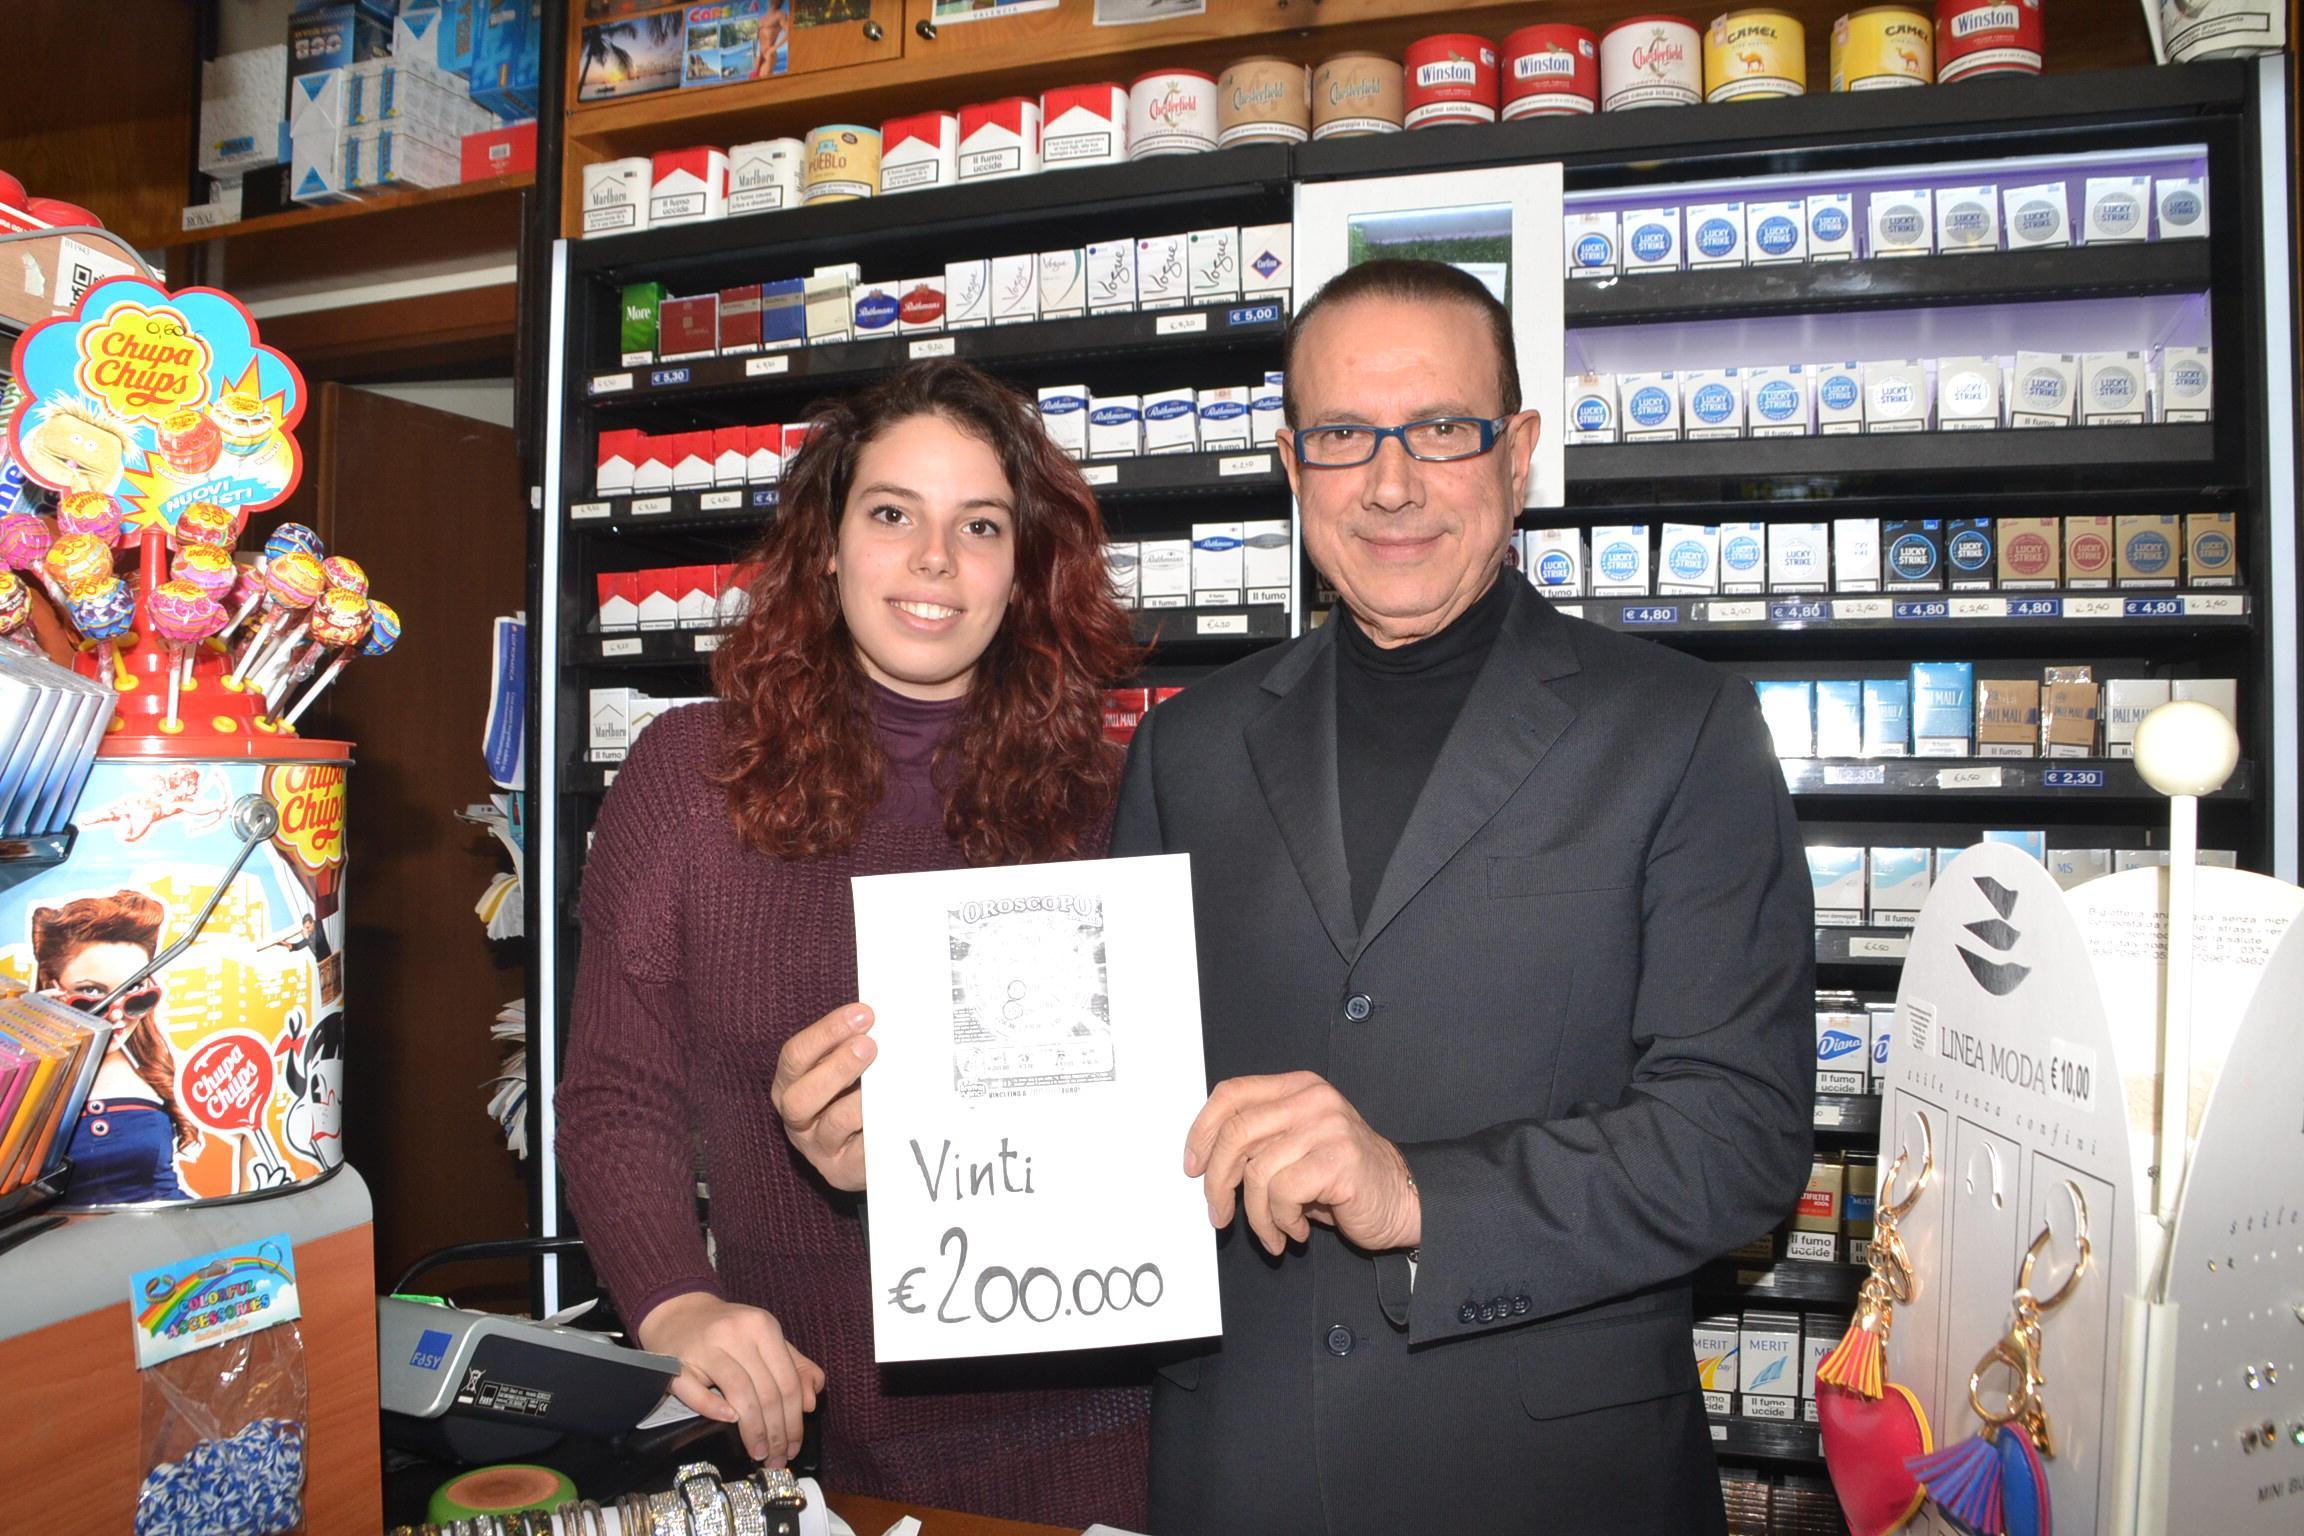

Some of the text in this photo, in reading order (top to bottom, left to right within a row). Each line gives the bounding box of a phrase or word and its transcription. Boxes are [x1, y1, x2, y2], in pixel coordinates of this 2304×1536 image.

[1957, 11, 2014, 34] Winston
[1728, 26, 1778, 44] CAMEL
[1885, 24, 1930, 44] CAMEL
[1632, 46, 1684, 70] Chesterfield
[1520, 55, 1570, 75] Winston
[1422, 66, 1471, 83] Winston
[1149, 98, 1197, 120] Chesterfield
[738, 168, 775, 187] Marlboro
[592, 187, 627, 206] Marlboro
[2102, 203, 2130, 213] LUCKY
[1889, 216, 1916, 226] LUCKY
[2024, 211, 2051, 221] LUCKY
[1703, 228, 1729, 241] LUCKY
[1764, 225, 1790, 238] LUCKY
[1639, 233, 1665, 245] LUCKY
[1702, 236, 1730, 247] STRIKE
[1763, 234, 1791, 245] STRIKE
[1580, 242, 1605, 254] LUCKY
[1638, 241, 1666, 251] STRIKE
[1194, 232, 1235, 290] Vogue
[1579, 251, 1606, 262] STRIKE
[1092, 245, 1129, 300] Vogue
[1143, 239, 1180, 295] Vogue
[626, 305, 652, 322] More
[1232, 308, 1273, 322] € 5,00
[145, 321, 187, 340] 0,60
[100, 331, 194, 370] Chupa
[94, 358, 189, 395] Chups
[653, 370, 686, 384] € 5,30
[2031, 378, 2059, 388] LUCKY
[2100, 378, 2128, 388] LUCKY
[1764, 390, 1790, 401] LUCKY
[1881, 386, 1909, 396] LUCKY
[2029, 386, 2059, 397] STRIKE
[2099, 386, 2129, 396] STRIKE
[1638, 397, 1663, 408] LUCKY
[1702, 395, 1727, 405] LUCKY
[1763, 399, 1793, 410] STRIKE
[1148, 404, 1191, 417] Rothmans
[1204, 404, 1244, 417] Rothmans
[1578, 406, 1604, 417] LUCKY
[1637, 405, 1666, 415] STRIKE
[1701, 402, 1728, 413] STRIKE
[1091, 408, 1133, 424] Rothmans
[1577, 413, 1606, 424] STRIKE
[166, 477, 230, 515] NUOVI
[1958, 541, 1983, 551] LUCKY
[2015, 544, 2042, 554] LUCKY
[2077, 543, 2101, 552] LUCKY
[2134, 543, 2161, 553] LUCKY
[2200, 540, 2225, 550] LUCKY
[1608, 552, 1633, 562] LUCKY
[1677, 550, 1702, 561] LUCKY
[1785, 550, 1811, 560] LUCKY
[1899, 547, 1927, 556] LUCKY
[1957, 548, 1984, 558] STRIKE
[2014, 551, 2044, 562] STRIKE
[2133, 551, 2163, 561] STRIKE
[1543, 560, 1567, 570] LUCKY
[1606, 560, 1634, 570] STRIKE
[1675, 557, 1704, 569] STRIKE
[1784, 558, 1812, 566] STRIKE
[1898, 554, 1929, 565] STRIKE
[1542, 568, 1569, 579] STRIKE
[1252, 590, 1287, 601] Il fumo
[1774, 606, 1821, 618] € 4,80
[1897, 604, 1945, 616] € 4,80
[2018, 602, 2051, 615] 4,80
[2126, 602, 2177, 614] € 4,80
[1626, 608, 1671, 621] € 4,80
[1120, 712, 1138, 727] MALL
[2002, 708, 2021, 723] MALL
[2112, 707, 2131, 723] PALL
[594, 722, 627, 738] Marlboro
[602, 751, 622, 760] fumo
[1999, 747, 2022, 756] fumo
[2048, 772, 2097, 785] € 2,30
[2057, 863, 2073, 874] MS
[962, 895, 1093, 925] OROSCOPO
[1892, 914, 1916, 923] fumo
[1819, 1037, 1862, 1055] Diana
[1941, 1026, 1986, 1073] LINEA
[1990, 1043, 2047, 1096] MODA
[191, 1043, 245, 1103] Chupa
[1828, 1074, 1856, 1084] fumo
[207, 1059, 259, 1118] Chups
[1821, 1084, 1856, 1092] uccide
[1954, 1088, 2001, 1118] senza
[2015, 1113, 2097, 1157] confini
[909, 1137, 1035, 1202] Vinti
[1791, 1233, 1832, 1247] Il fumo
[1791, 1246, 1831, 1258] uccide
[178, 1279, 257, 1315] COLORFUL
[168, 1294, 271, 1339] ACCESSORIES
[1749, 1339, 1789, 1352] MERIT
[1759, 1398, 1786, 1407] fumo
[1751, 1406, 1785, 1417] uccide
